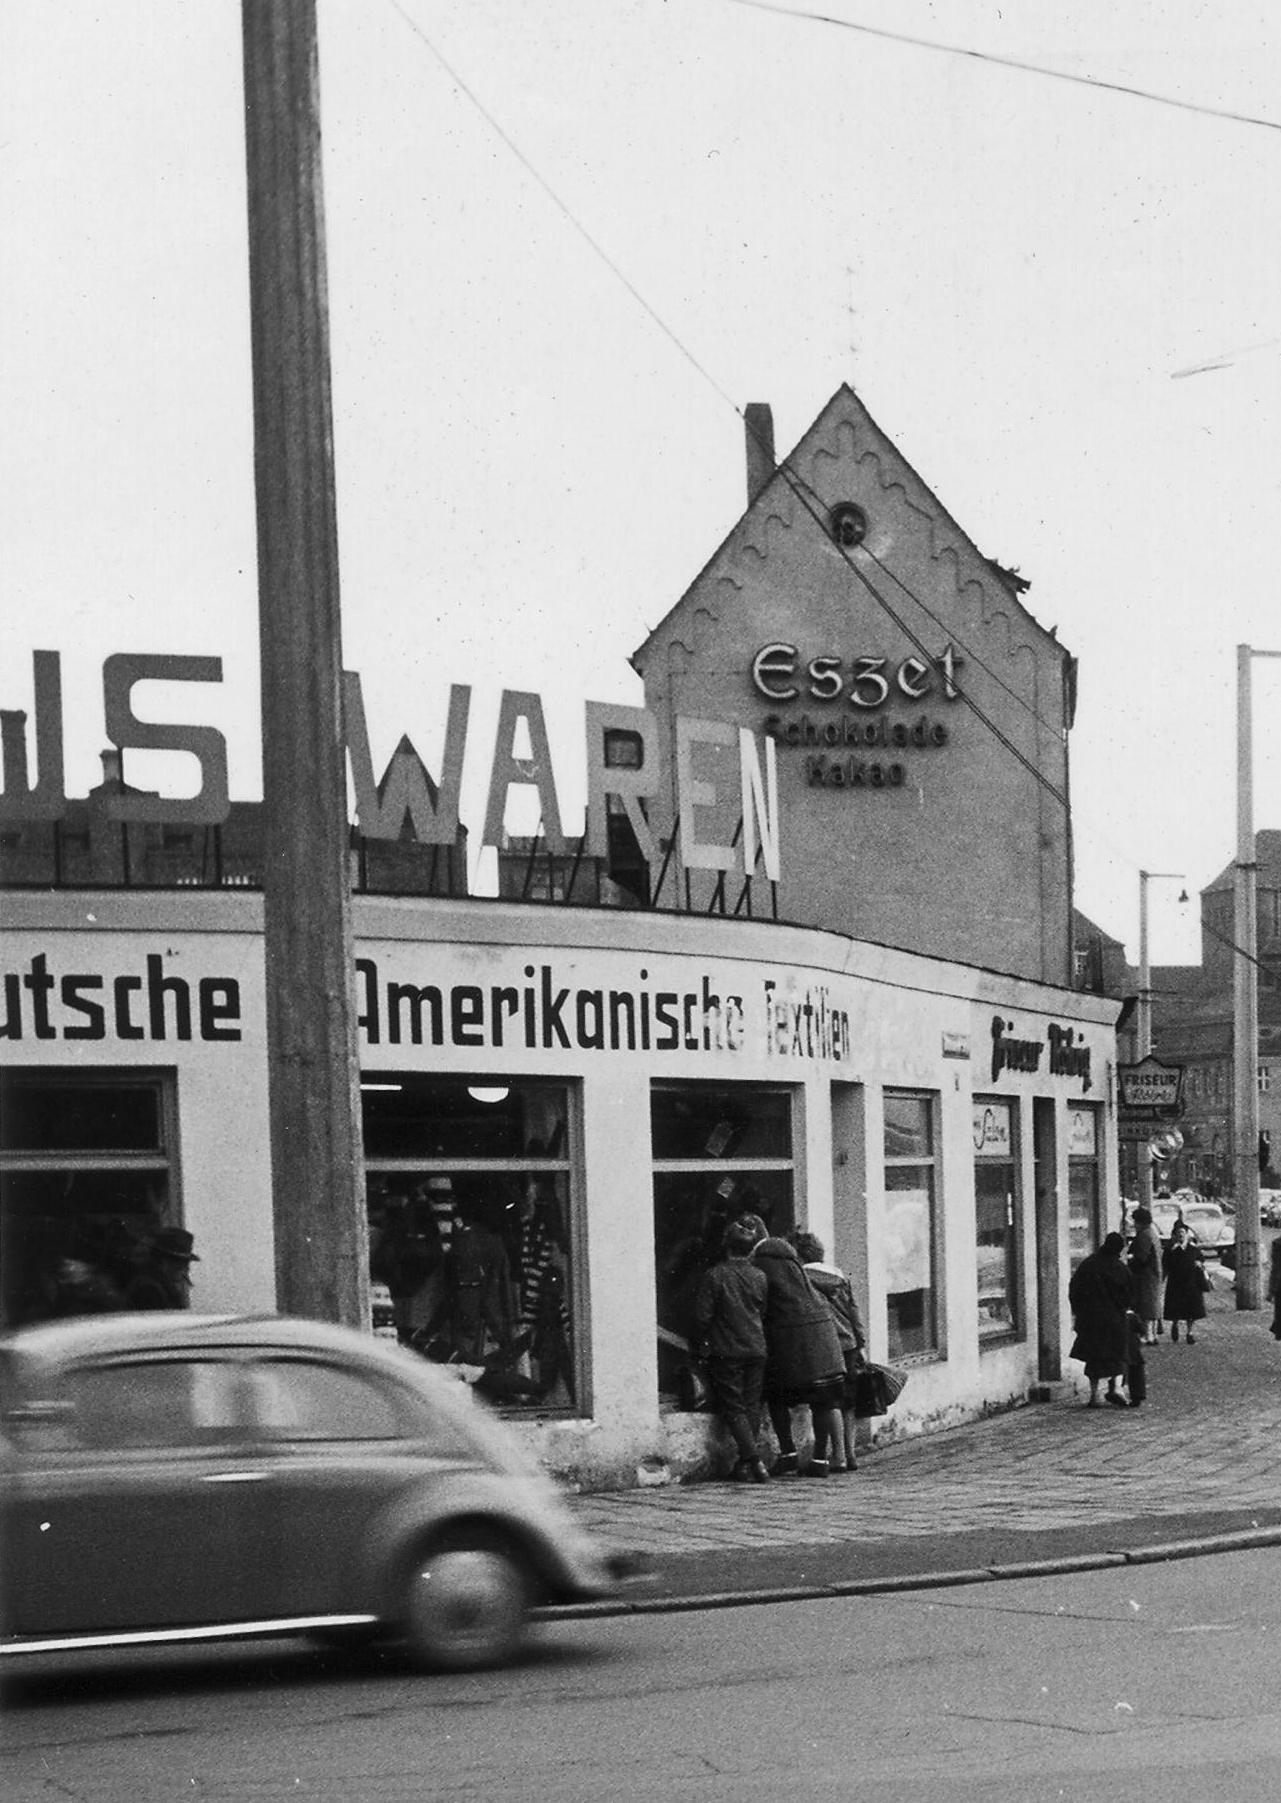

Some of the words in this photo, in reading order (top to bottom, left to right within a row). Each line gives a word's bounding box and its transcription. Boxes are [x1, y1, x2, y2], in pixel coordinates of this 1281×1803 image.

[753, 642, 964, 706] Eszet
[763, 714, 949, 749] Schokolade
[343, 670, 781, 881] WAREN
[805, 754, 907, 788] Kakao
[1124, 1074, 1177, 1086] FRISEUR
